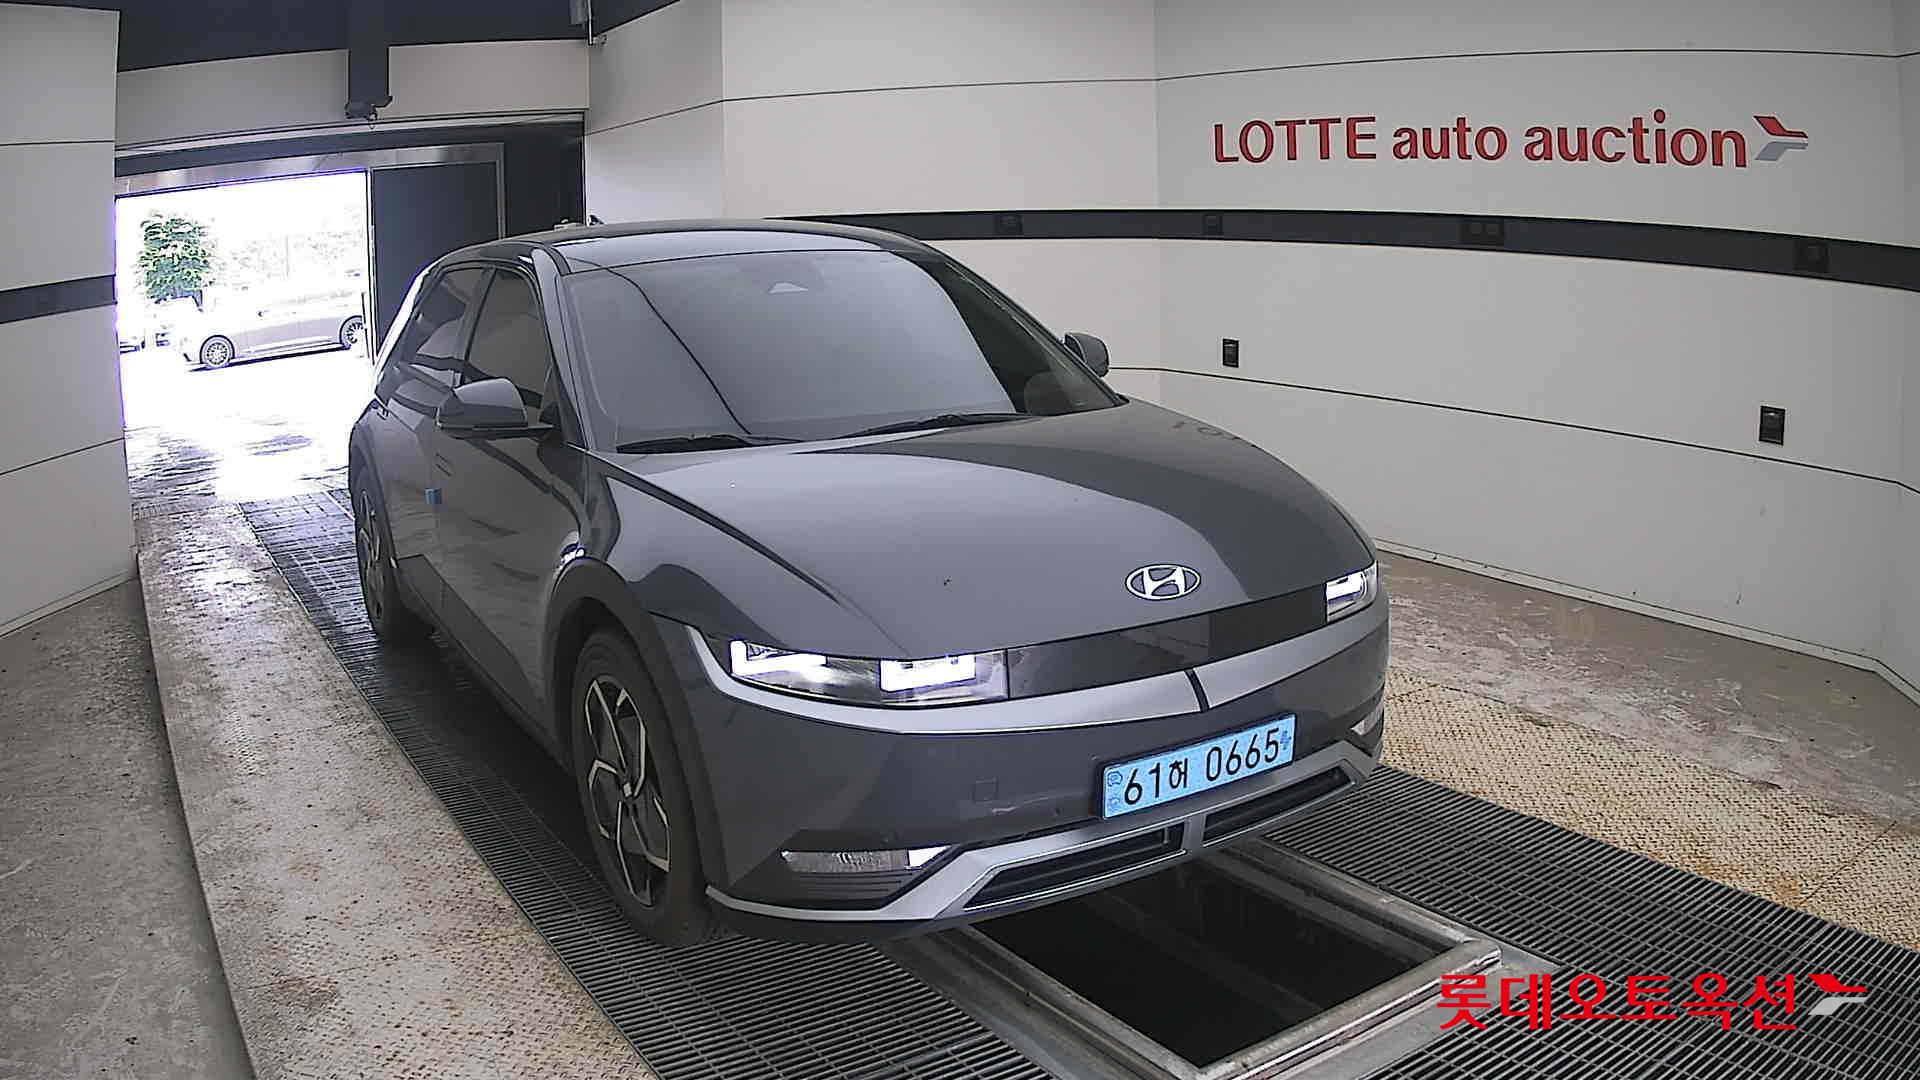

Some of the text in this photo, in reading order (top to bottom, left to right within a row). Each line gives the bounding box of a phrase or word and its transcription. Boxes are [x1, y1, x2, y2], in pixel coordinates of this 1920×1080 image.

[1214, 109, 1747, 167] LOTTE auto auction
[1124, 728, 1279, 805] 61허 0665
